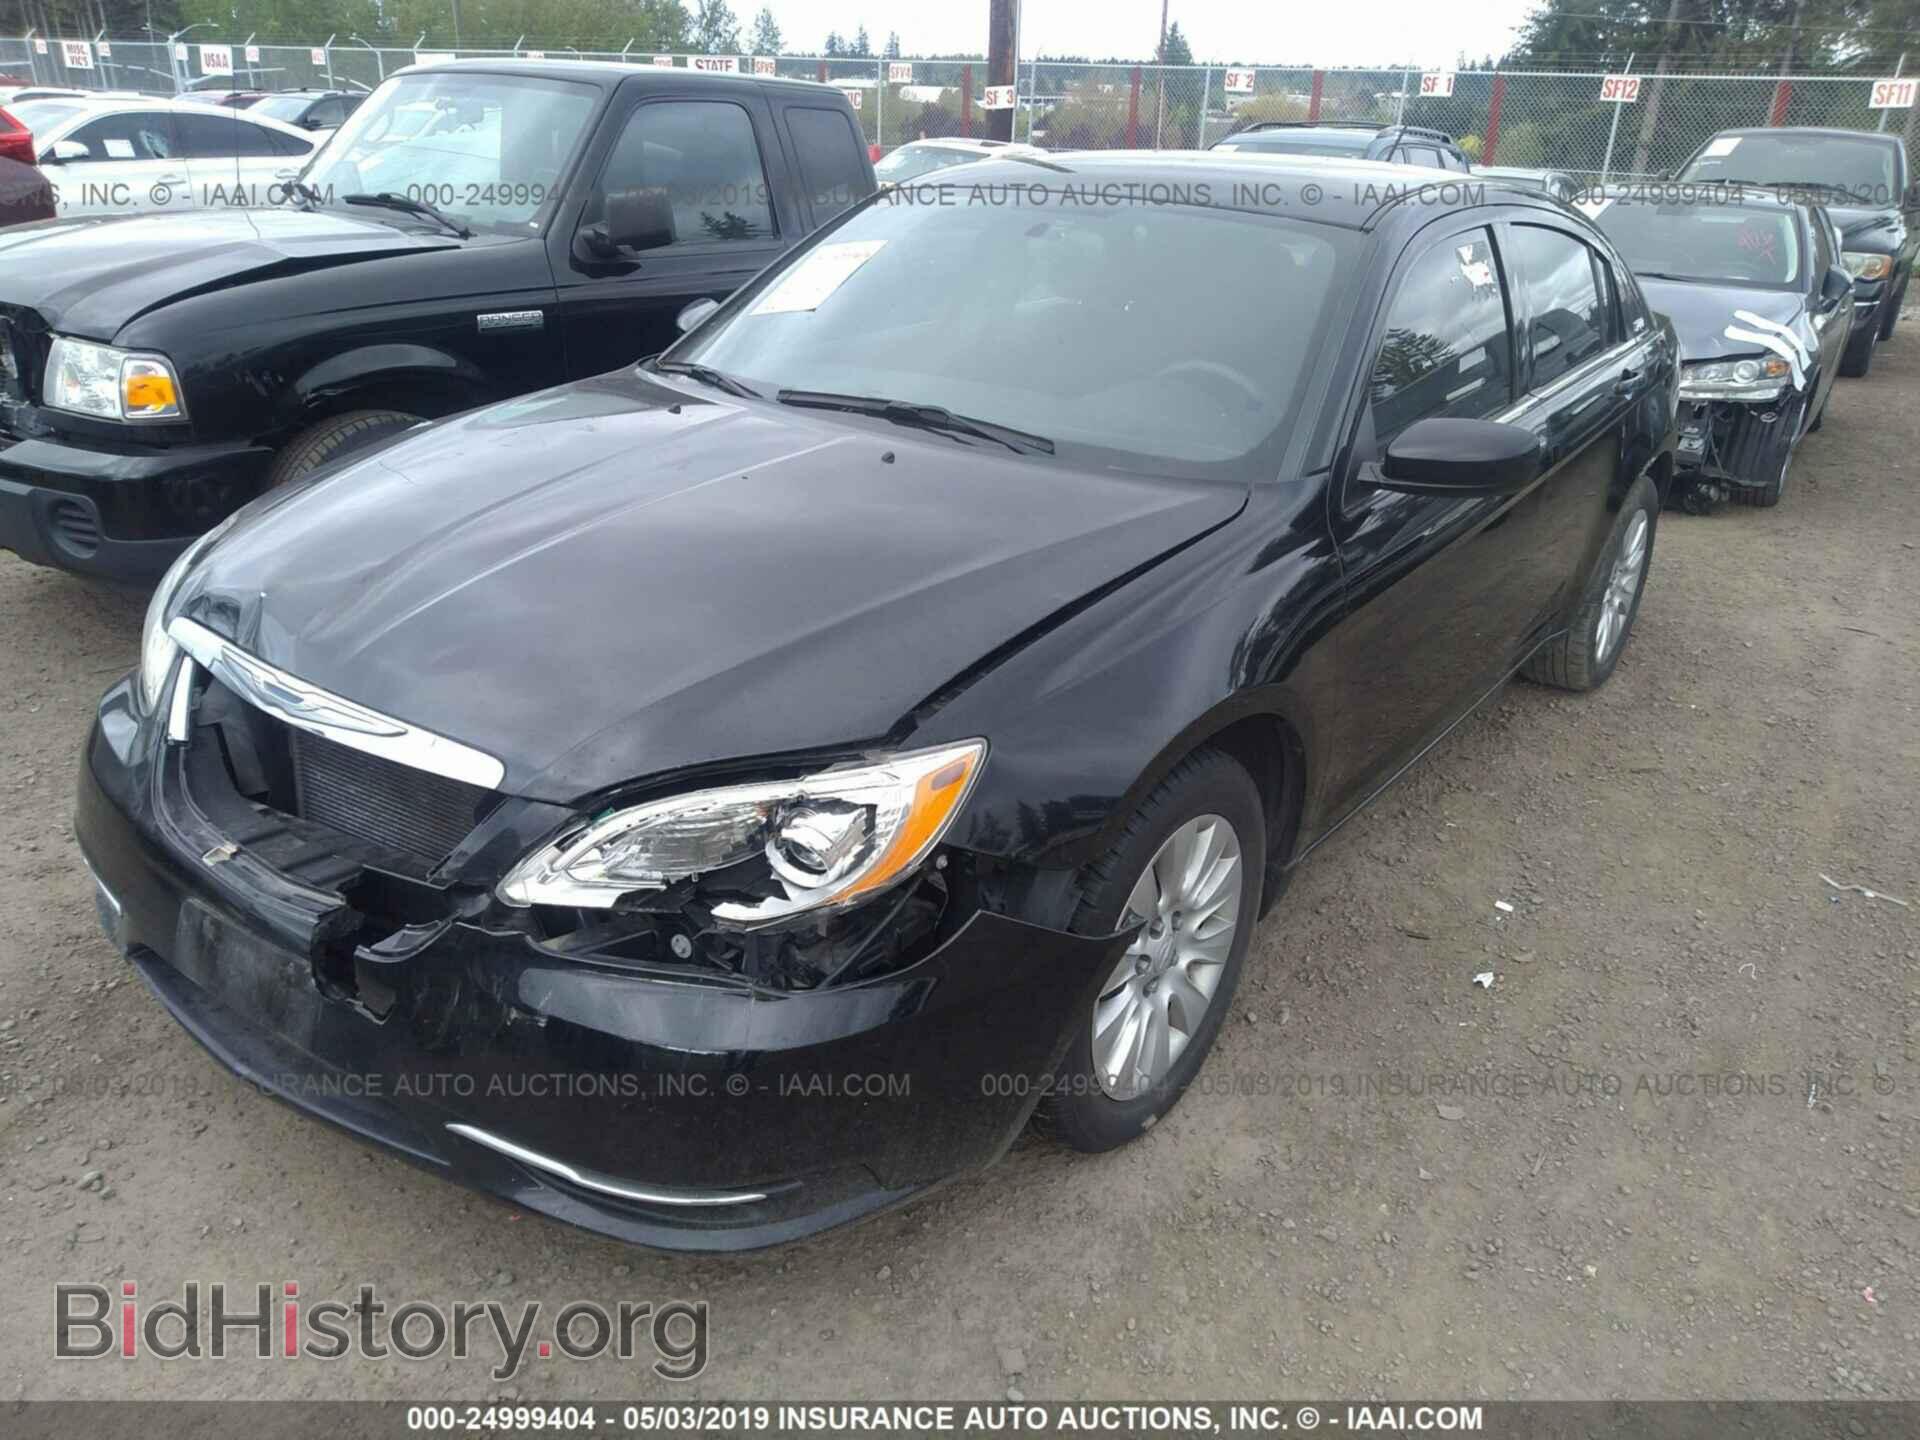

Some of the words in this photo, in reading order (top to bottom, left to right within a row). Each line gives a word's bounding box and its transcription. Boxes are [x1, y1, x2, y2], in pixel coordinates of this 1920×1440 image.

[203, 52, 229, 68] USAA
[1225, 72, 1240, 88] SF
[1245, 73, 1254, 88] 2
[1421, 77, 1439, 93] SF
[1446, 77, 1453, 93] 1
[1602, 78, 1638, 99] SF12
[986, 91, 998, 106] SF
[1006, 89, 1014, 104] 3
[1873, 83, 1913, 105] SF11
[476, 311, 544, 329] RANGER
